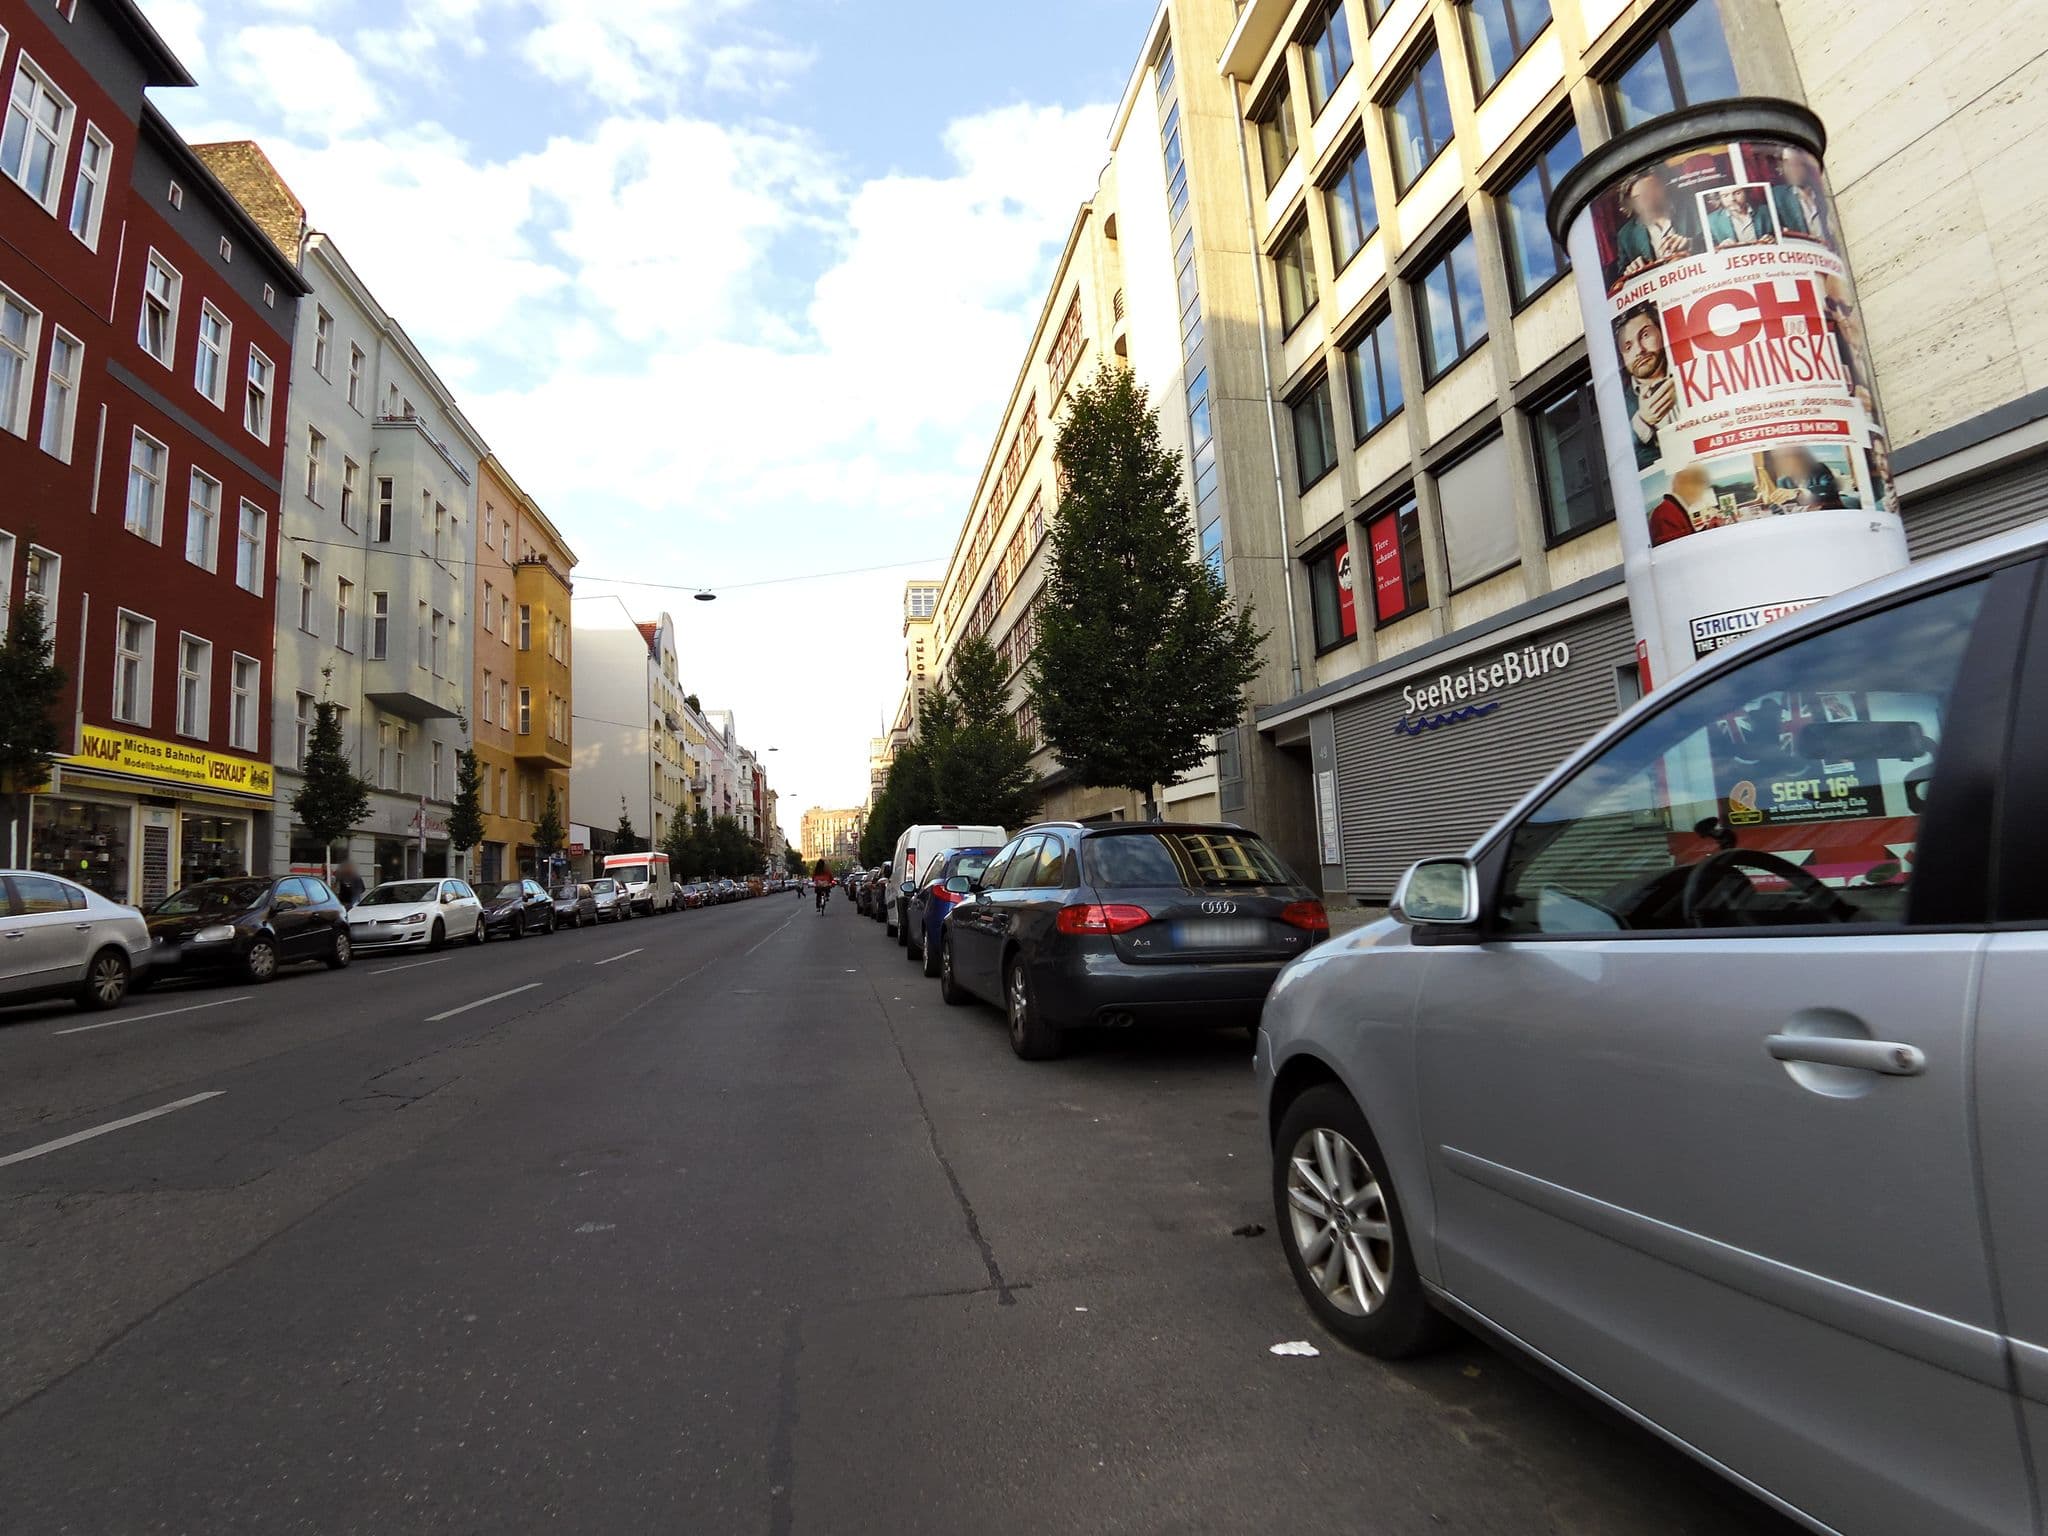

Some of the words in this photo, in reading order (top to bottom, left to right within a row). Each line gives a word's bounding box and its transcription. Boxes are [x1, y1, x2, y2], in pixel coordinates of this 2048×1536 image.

[1725, 251, 1775, 270] JESPER
[1616, 282, 1657, 310] DANIEL
[1659, 263, 1706, 287] BRÜHL
[1663, 280, 1824, 365] ICH
[1678, 333, 1841, 407] KAMINSKI
[1701, 411, 1729, 423] CASAR
[1735, 403, 1762, 415] DENIS
[1763, 399, 1795, 411] LAVANT
[1736, 411, 1785, 424] GERALDINE
[1709, 436, 1723, 448] AB
[1739, 425, 1801, 441] SEPTEMBER
[1815, 422, 1839, 432] KINO
[1374, 539, 1389, 551] Tiere
[1696, 611, 1760, 637] STRICTLY
[1695, 639, 1715, 652] THE
[1403, 642, 1569, 714] SeeReiseBüro
[124, 738, 162, 757] Michas
[165, 747, 206, 765] Bahnhof
[208, 760, 247, 783] VERKAUF
[124, 756, 206, 780] Modellbahnfundgrube
[1771, 779, 1821, 802] SEPT
[1827, 775, 1859, 798] 16th
[1133, 939, 1151, 947] A4
